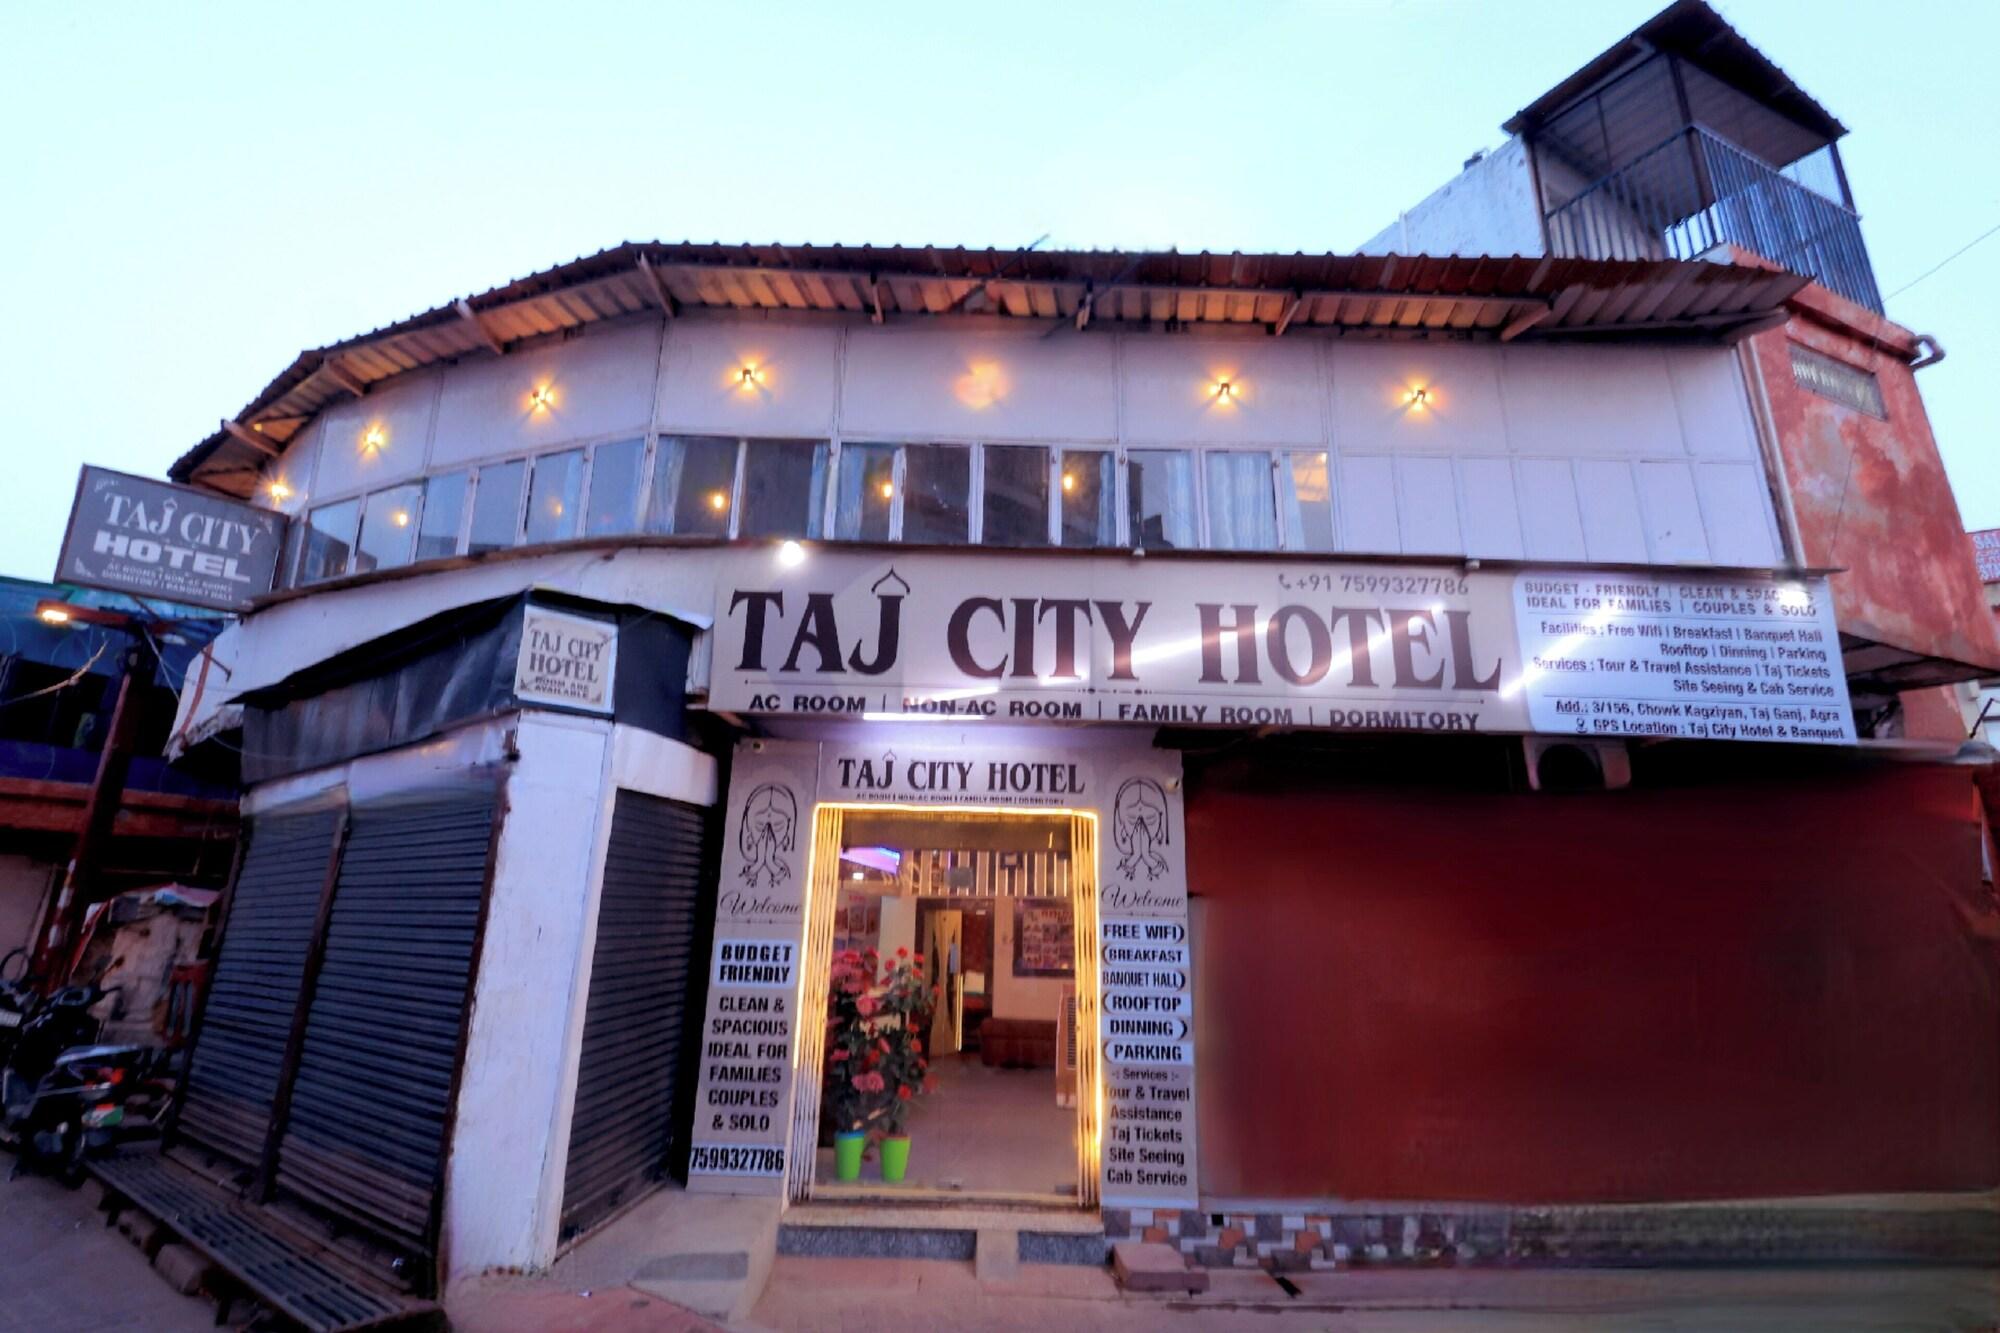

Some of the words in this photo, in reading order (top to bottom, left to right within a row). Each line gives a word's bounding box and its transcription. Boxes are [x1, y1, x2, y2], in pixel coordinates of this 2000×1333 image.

[104, 492, 178, 535] TAJ
[180, 512, 261, 555] CITY
[93, 530, 250, 582] HOTEL
[1296, 575, 1331, 593] +91
[1340, 574, 1469, 597] 7599327786
[1524, 582, 1579, 595] BUDGET
[1595, 584, 1660, 598] FRIENDLY
[1679, 586, 1724, 600] CLEAN
[1527, 597, 1567, 609] IDEAL
[1574, 598, 1601, 610] FOR
[1608, 600, 1671, 613] FAMILIES
[1692, 601, 1756, 615] COUPLES
[1764, 604, 1773, 616] &
[1781, 604, 1816, 617] SOLO
[728, 586, 907, 676] TAJ
[947, 597, 1152, 681] CITY
[1195, 602, 1502, 693] HOTEL
[1608, 624, 1634, 636] Free
[1673, 625, 1733, 640] Breakfast
[1744, 628, 1796, 643] Banquet
[1798, 629, 1823, 642] Hall
[530, 628, 561, 653] TAJ
[568, 638, 604, 661] CITY
[1660, 643, 1708, 660] Rooftop
[1720, 645, 1767, 661] Dinning
[1778, 647, 1827, 662] Parking
[529, 652, 600, 684] HOTEL
[1597, 659, 1625, 672] Tour
[1630, 660, 1639, 672] &
[1643, 660, 1681, 674] Travel
[1685, 662, 1751, 676] Assistance
[1764, 665, 1783, 679] Taj
[1787, 666, 1830, 679] Tickets
[1673, 680, 1698, 693] Site
[1700, 681, 1744, 697] Seeing
[1748, 683, 1757, 695] &
[1760, 683, 1784, 696] Cab
[1787, 683, 1834, 697] Service
[749, 694, 781, 712] AC
[793, 695, 866, 713] ROOM
[902, 697, 997, 716] NON-AC
[1009, 699, 1082, 718] ROOM
[1118, 703, 1207, 724] FAMILY
[1220, 706, 1293, 727] ROOM
[1329, 709, 1479, 731] DORMITORY
[1637, 702, 1681, 717] Chowk
[1751, 705, 1770, 722] Taj
[1810, 708, 1839, 723] Agra
[1593, 719, 1619, 733] GPS
[1623, 720, 1678, 735] Location
[1688, 722, 1708, 738] Taj
[1712, 723, 1736, 739] City
[1740, 724, 1773, 738] Hotel
[1776, 726, 1787, 738] &
[1791, 726, 1844, 742] Banquet
[838, 757, 895, 789] TAJ
[907, 759, 975, 793] CITY
[987, 761, 1086, 794] HOTEL
[720, 890, 801, 917] Welcome
[1101, 884, 1184, 909] Welcome
[1103, 924, 1140, 940] FREE
[721, 944, 792, 963] BUDGET
[1109, 948, 1182, 963] BREAKFAST
[719, 964, 790, 984] FRIENDLY
[1102, 971, 1149, 988] BANQUET
[719, 996, 769, 1013] CLEAN
[773, 997, 785, 1013] &
[1112, 995, 1182, 1011] ROOFTOP
[712, 1019, 788, 1037] SPACIOUS
[1110, 1019, 1173, 1036] DINNING
[708, 1042, 750, 1059] IDEAL
[757, 1043, 788, 1060] FOR
[1114, 1044, 1182, 1061] PARKING
[709, 1065, 782, 1084] FAMILIES
[708, 1088, 779, 1108] COUPLES
[1103, 1084, 1131, 1099] Tour
[1135, 1085, 1145, 1100] &
[1149, 1085, 1190, 1101] Travel
[1110, 1104, 1182, 1121] Assistance
[712, 1114, 724, 1132] &
[729, 1114, 770, 1132] SOLO
[1110, 1126, 1130, 1144] Taj
[1134, 1126, 1182, 1143] Tickets
[690, 1146, 785, 1173] 7599327786
[1109, 1148, 1135, 1164] Site
[1139, 1148, 1185, 1168] Seeing
[1107, 1169, 1132, 1184] Cab
[1137, 1170, 1188, 1187] Service
